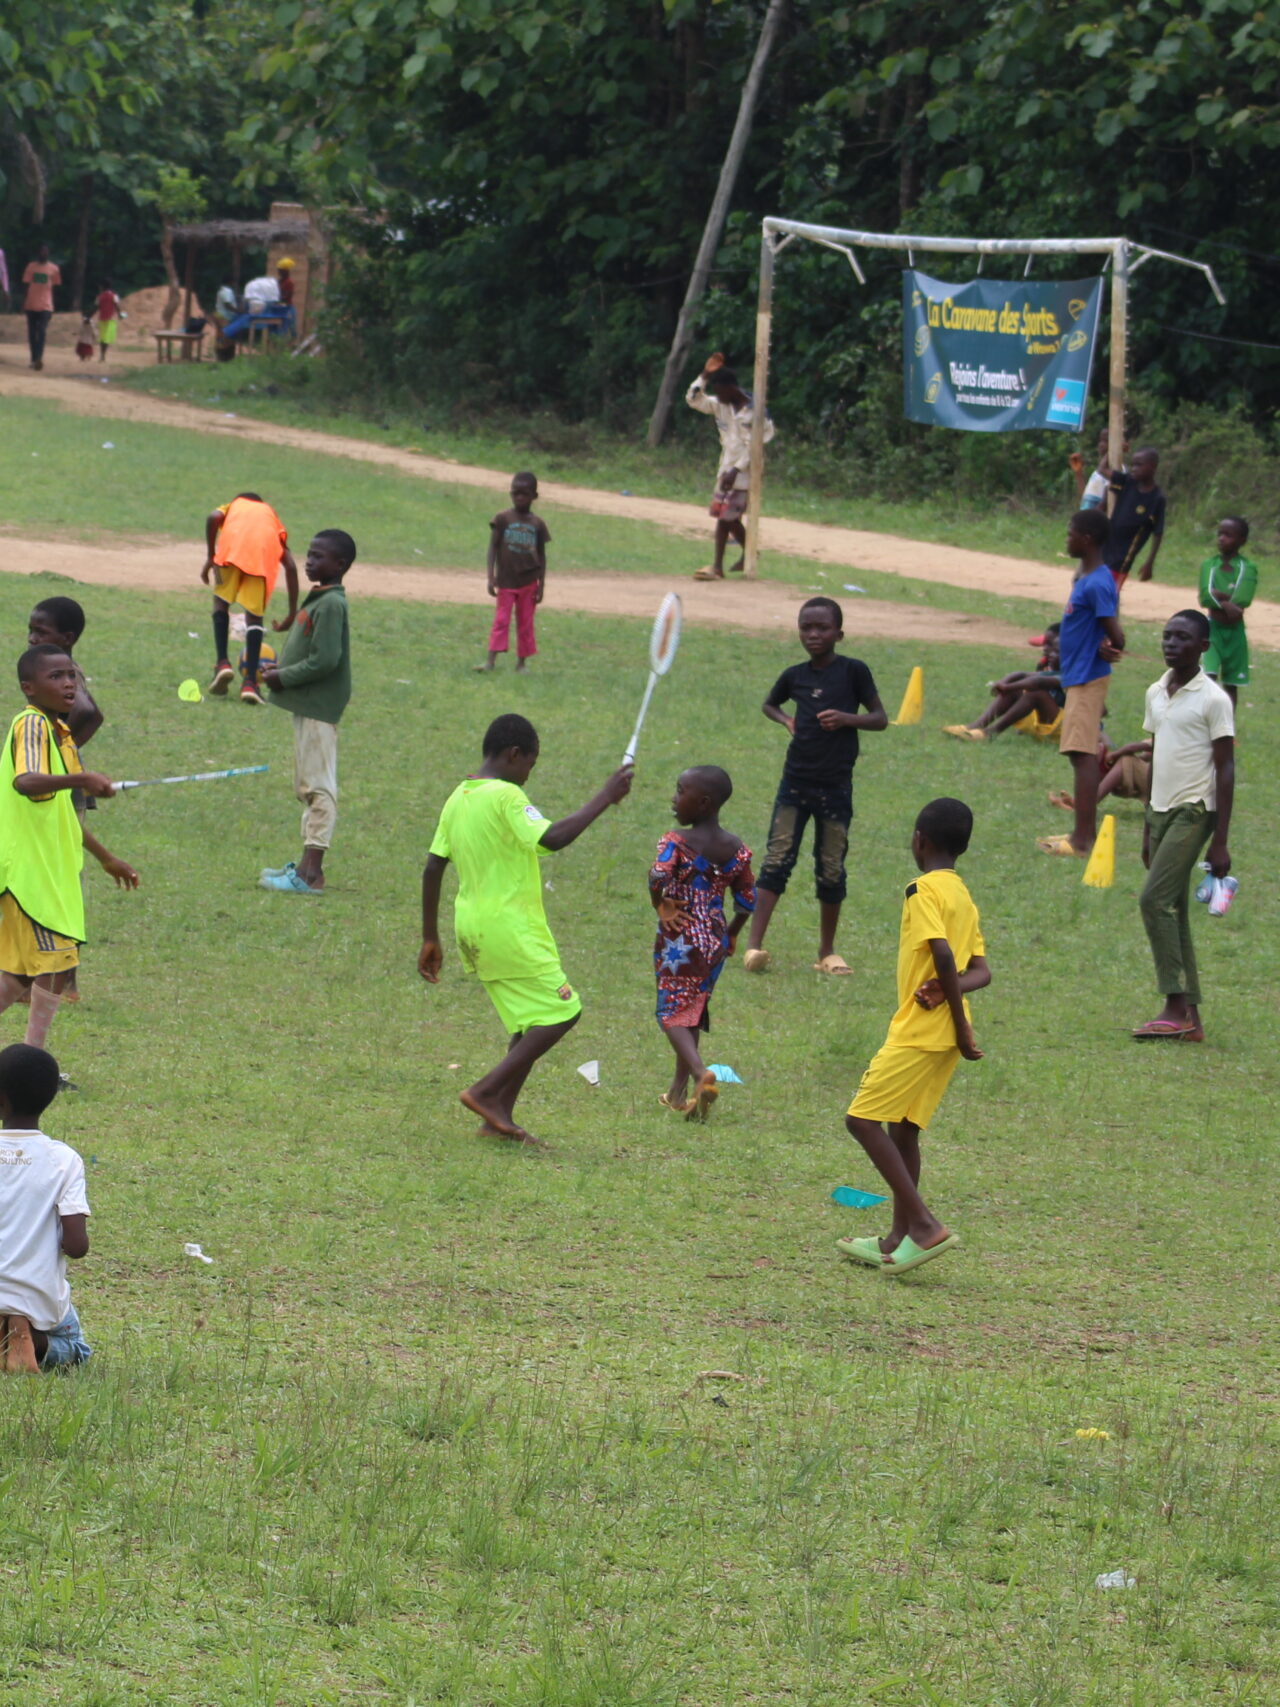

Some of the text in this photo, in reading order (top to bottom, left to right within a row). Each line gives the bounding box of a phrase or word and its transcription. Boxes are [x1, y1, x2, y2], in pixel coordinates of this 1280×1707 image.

[927, 296, 1060, 343] La Caravane des Sports
[949, 361, 977, 391] Rejoins
